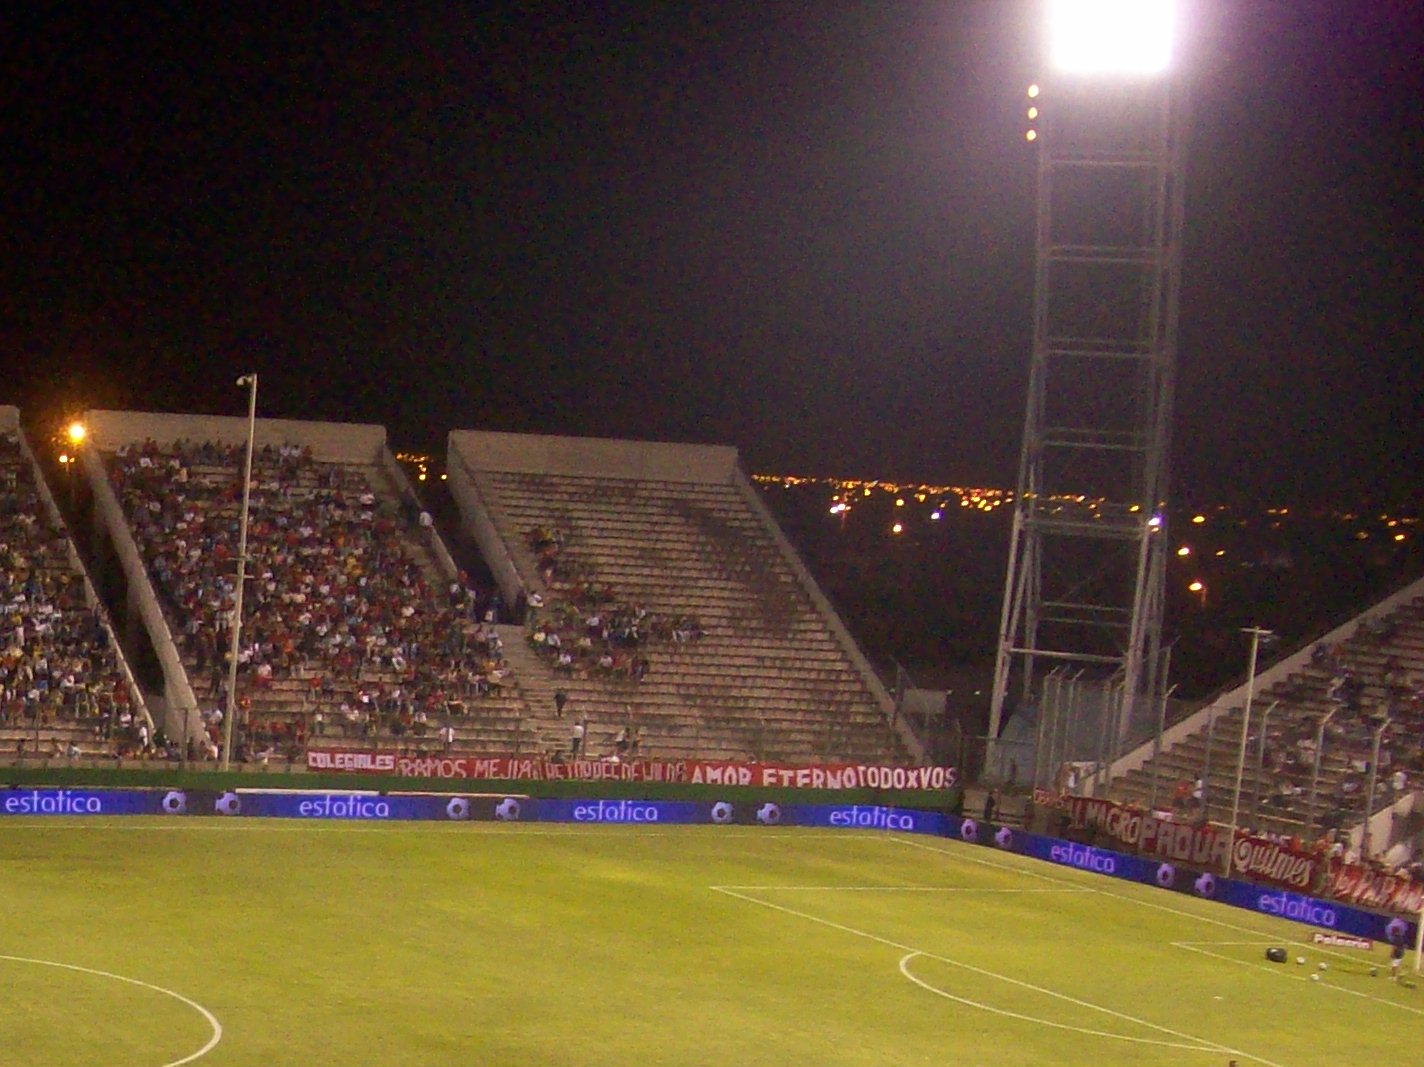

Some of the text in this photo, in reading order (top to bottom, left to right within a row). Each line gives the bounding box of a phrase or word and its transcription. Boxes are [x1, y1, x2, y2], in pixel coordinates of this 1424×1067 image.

[308, 752, 394, 770] COLEGIALES
[399, 758, 467, 778] RAMOS
[691, 765, 752, 785] AMOR
[6, 790, 101, 813] estatica
[299, 796, 390, 817] estatica
[574, 800, 659, 822] estatica
[830, 806, 914, 829] estatica
[1051, 842, 1115, 874] estatica
[1233, 837, 1314, 887] Quilmes
[1260, 892, 1336, 926] estatica
